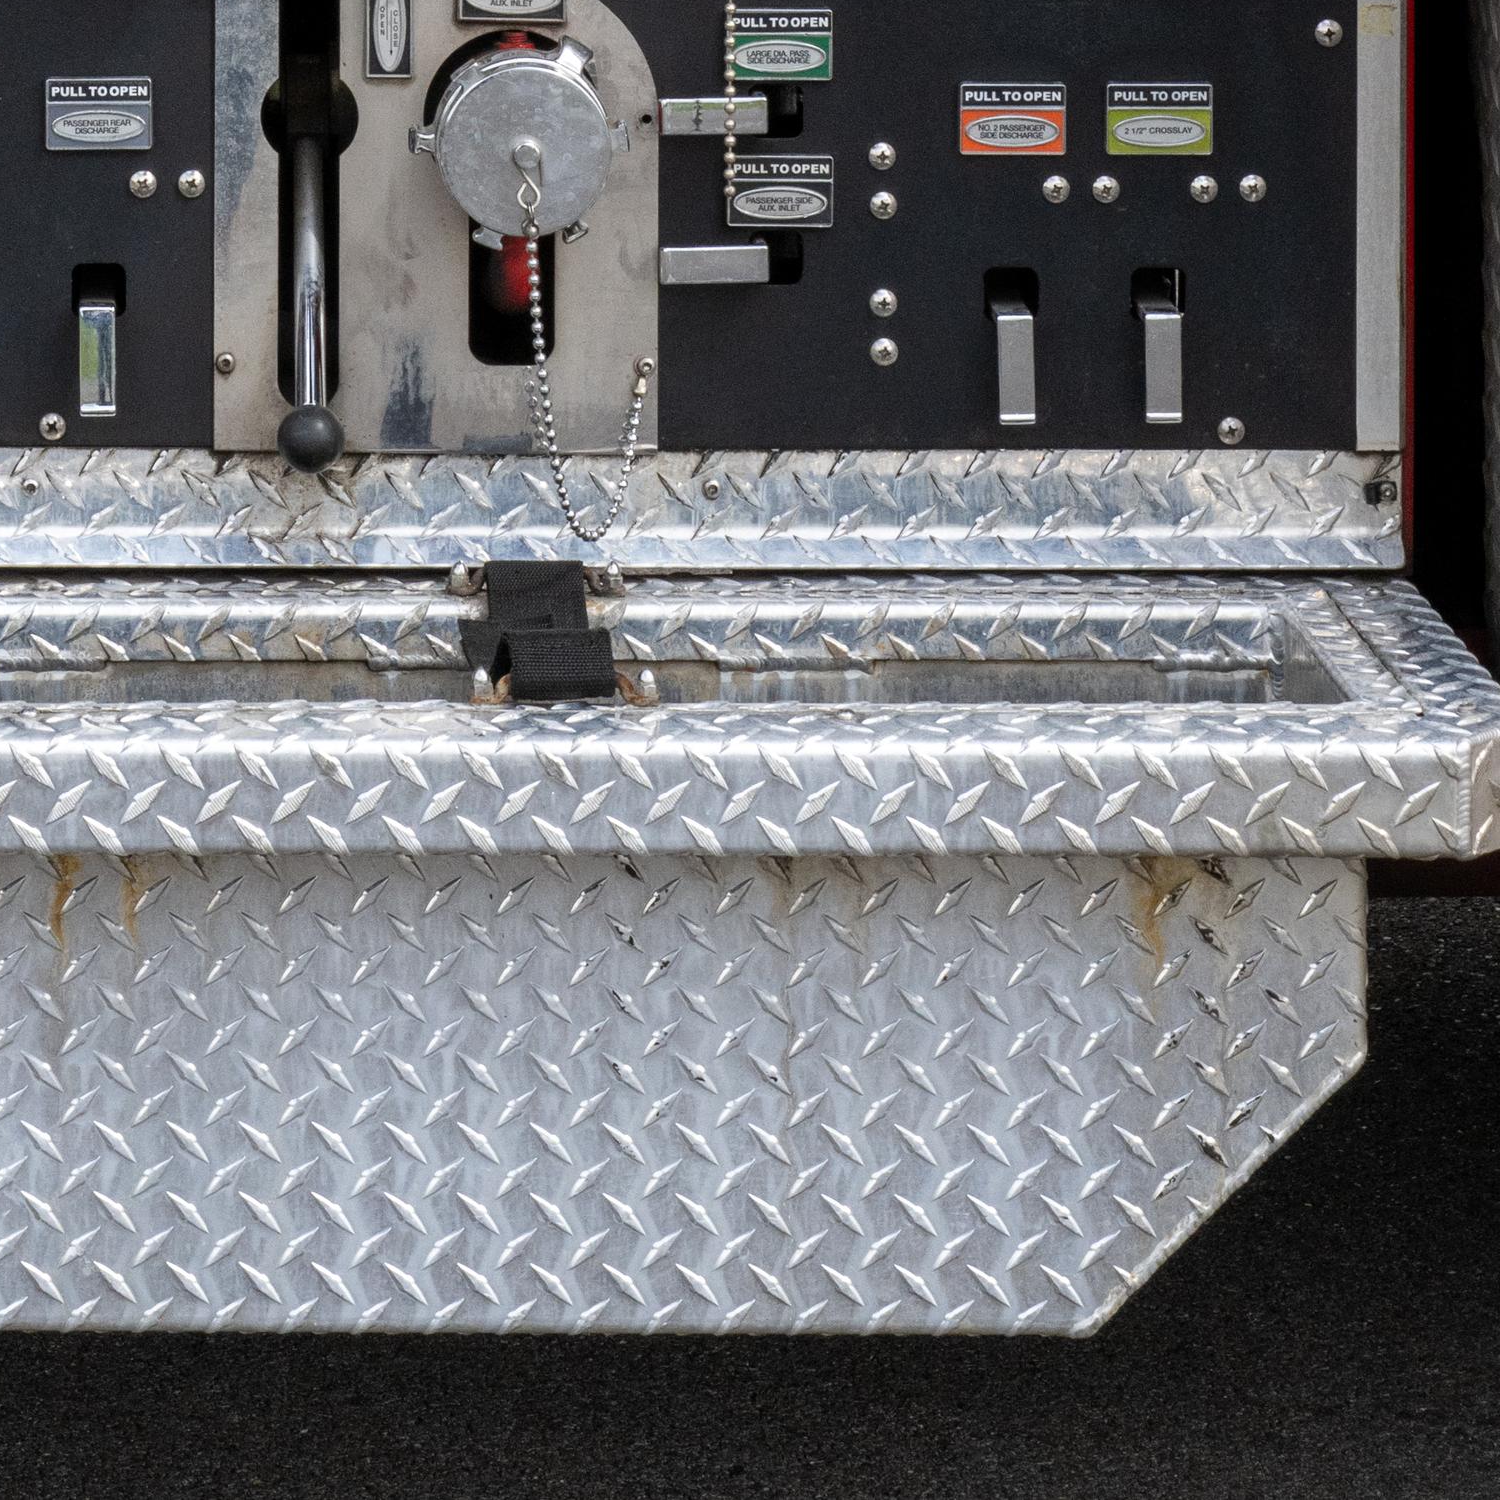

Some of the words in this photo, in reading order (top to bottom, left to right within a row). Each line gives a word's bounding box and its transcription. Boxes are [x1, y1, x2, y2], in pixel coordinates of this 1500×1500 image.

[733, 17, 767, 28] PULL
[769, 17, 789, 28] TO
[790, 17, 829, 28] OPEN
[51, 86, 86, 97] PULL
[88, 86, 108, 97] TO
[109, 86, 148, 97] OPEN
[965, 91, 1000, 102] PULL
[1002, 91, 1021, 102] TO
[1023, 91, 1061, 102] OPEN
[1114, 91, 1147, 101] PULL
[1150, 91, 1168, 101] TO
[1171, 91, 1207, 101] OPEN
[63, 119, 109, 127] PASSENGER
[110, 119, 131, 127] REAR
[979, 124, 991, 132] NO.
[994, 124, 998, 132] 2
[999, 124, 1045, 132] PASSENGER
[733, 164, 768, 174] PULL
[770, 164, 789, 174] TO
[791, 164, 830, 174] OPEN
